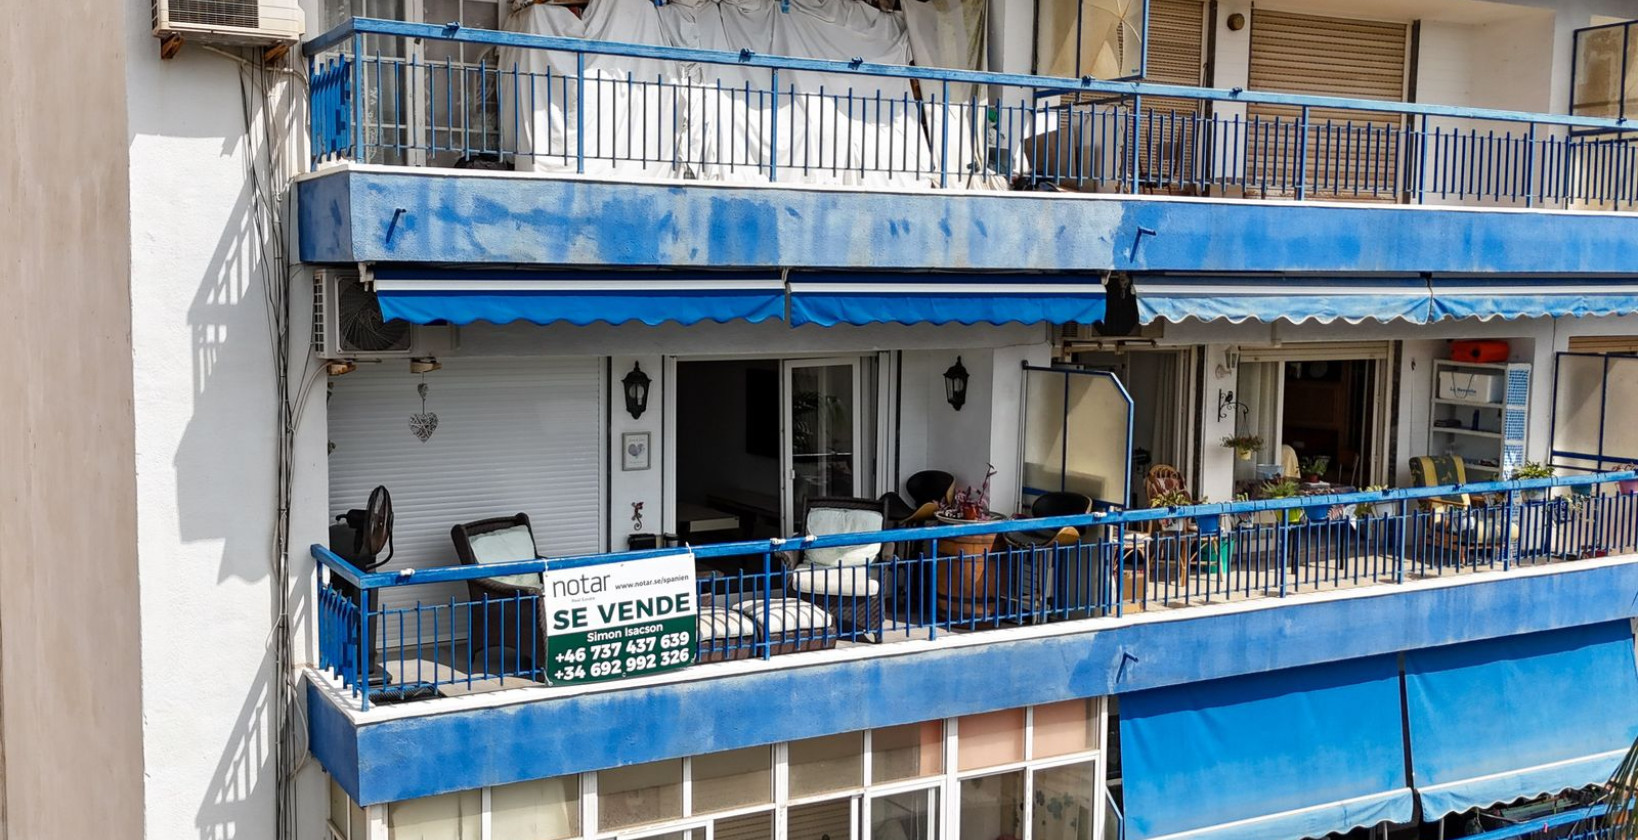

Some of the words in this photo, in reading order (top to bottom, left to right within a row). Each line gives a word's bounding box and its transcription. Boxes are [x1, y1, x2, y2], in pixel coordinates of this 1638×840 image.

[553, 574, 610, 597] notar
[615, 575, 689, 589] www.notar.se/spanien
[553, 607, 588, 630] SE
[597, 592, 690, 624] VENDE
[587, 630, 622, 642] Simon
[625, 623, 663, 637] Isacson
[555, 647, 586, 663] +46
[590, 642, 622, 660] 737
[626, 637, 657, 654] 437
[660, 631, 690, 649] 639
[554, 666, 586, 680] +34
[590, 660, 622, 677] 692
[626, 654, 657, 672] 992
[660, 648, 690, 666] 326
